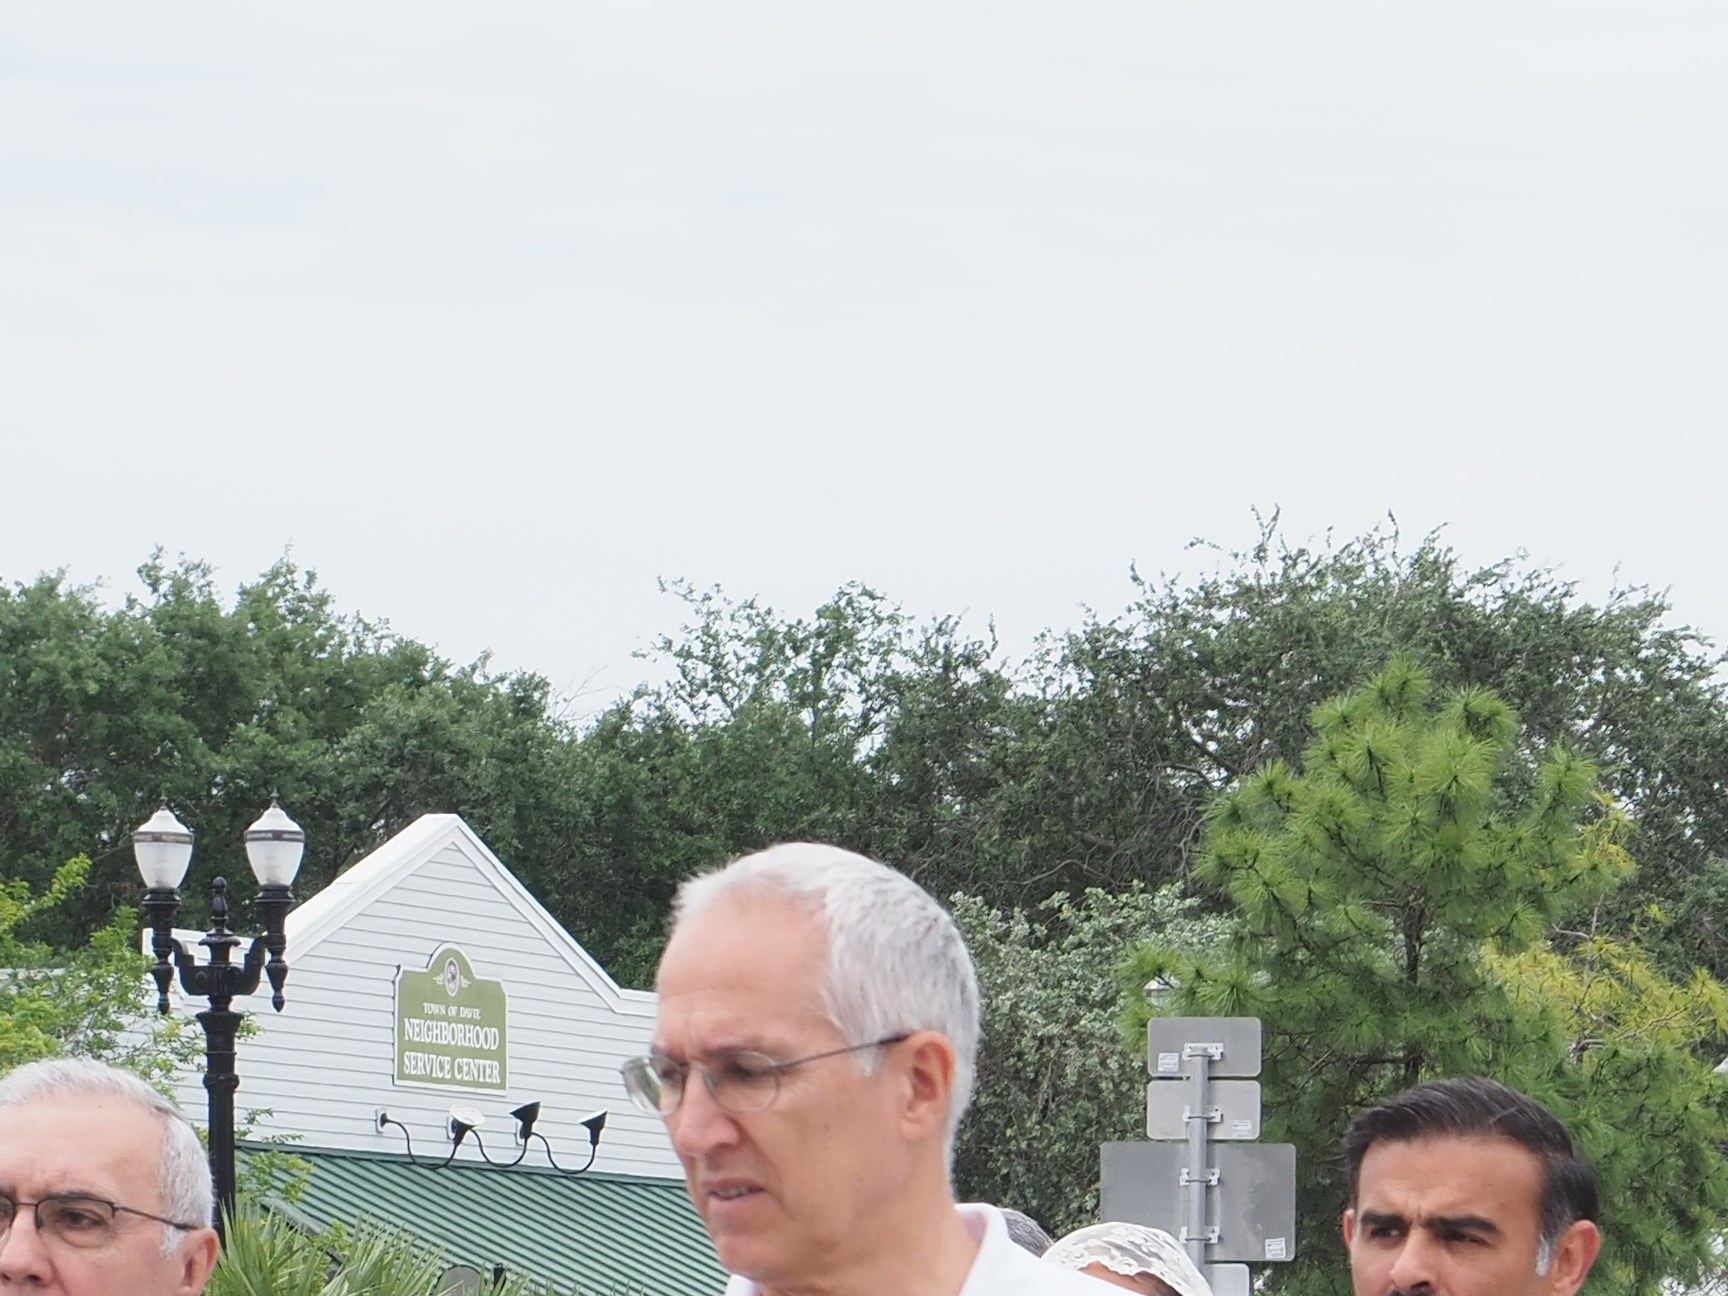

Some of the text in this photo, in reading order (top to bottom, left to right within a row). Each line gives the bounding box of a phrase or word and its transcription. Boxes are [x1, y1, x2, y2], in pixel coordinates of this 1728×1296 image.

[422, 1002, 446, 1015] TOWN
[447, 1006, 458, 1017] OF
[404, 1018, 500, 1051] NEIGHBORHOOD
[403, 1051, 501, 1084] SERVICE CENTER
